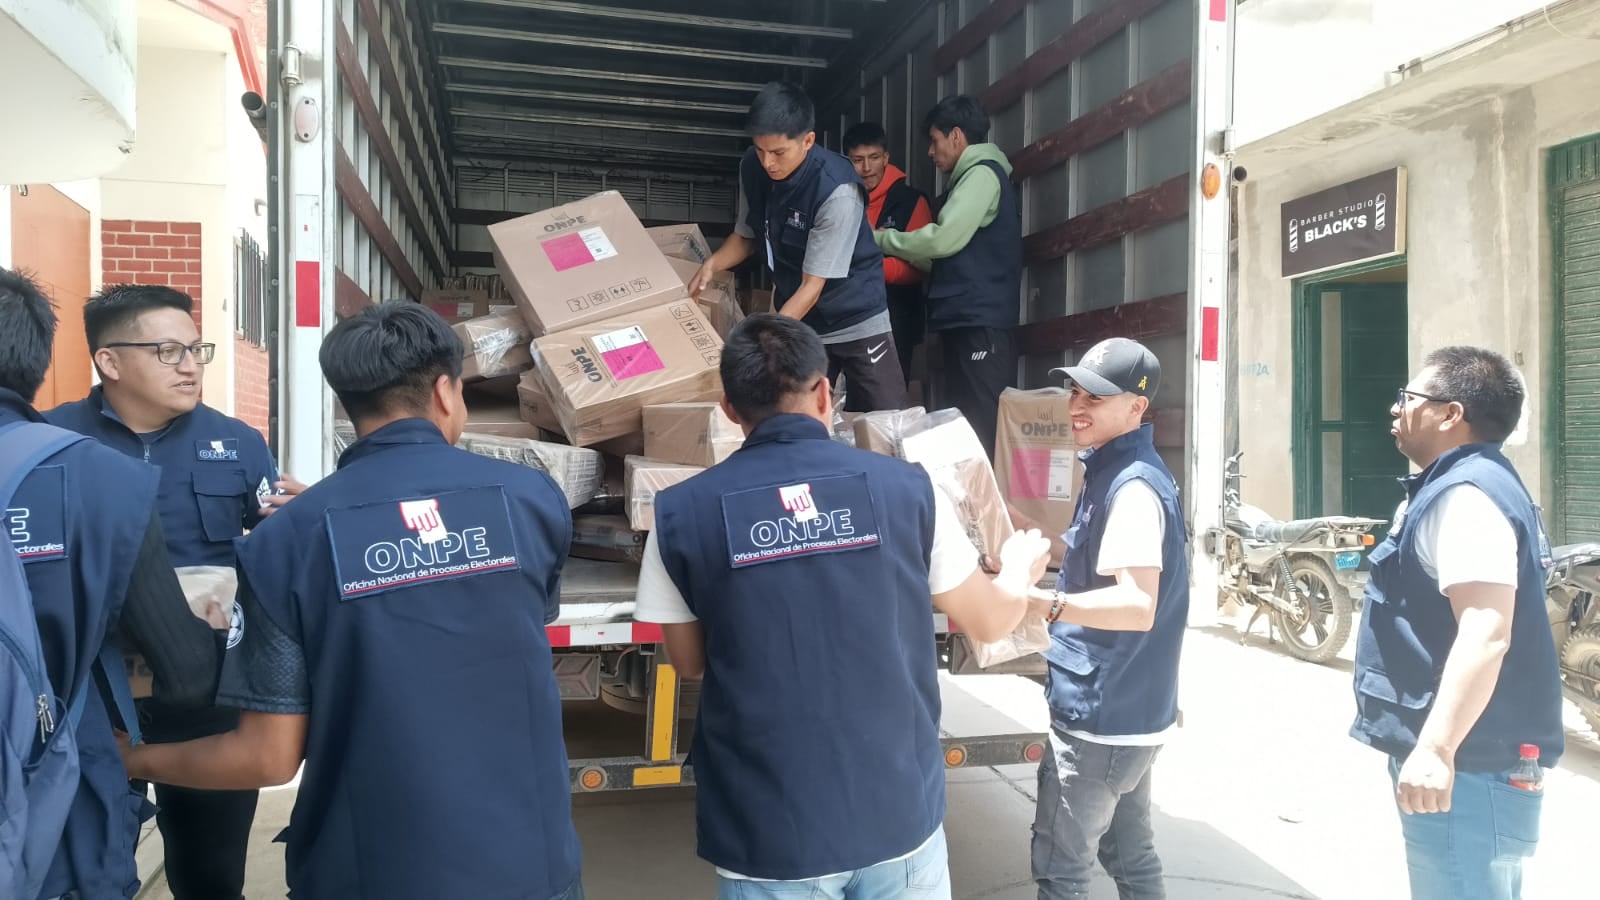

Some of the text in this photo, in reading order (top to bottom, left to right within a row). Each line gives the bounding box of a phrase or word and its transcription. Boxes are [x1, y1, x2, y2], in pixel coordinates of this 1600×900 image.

[543, 215, 587, 232] ONPE
[1300, 199, 1373, 226] BARBER STUDIO
[1304, 214, 1367, 243] BLACK'S
[571, 346, 602, 382] ONPE
[1021, 422, 1070, 437] ONPE
[199, 449, 238, 459] ONPE
[750, 508, 855, 547] ONPE
[15, 543, 65, 554] ctorales
[364, 526, 490, 574] ONPE
[733, 551, 760, 562] Oficina
[760, 546, 792, 558] Nacional
[803, 540, 837, 549] Procesos
[837, 532, 878, 545] Electorales
[343, 555, 516, 592] Oficina Nacional de Procesos Electorales
